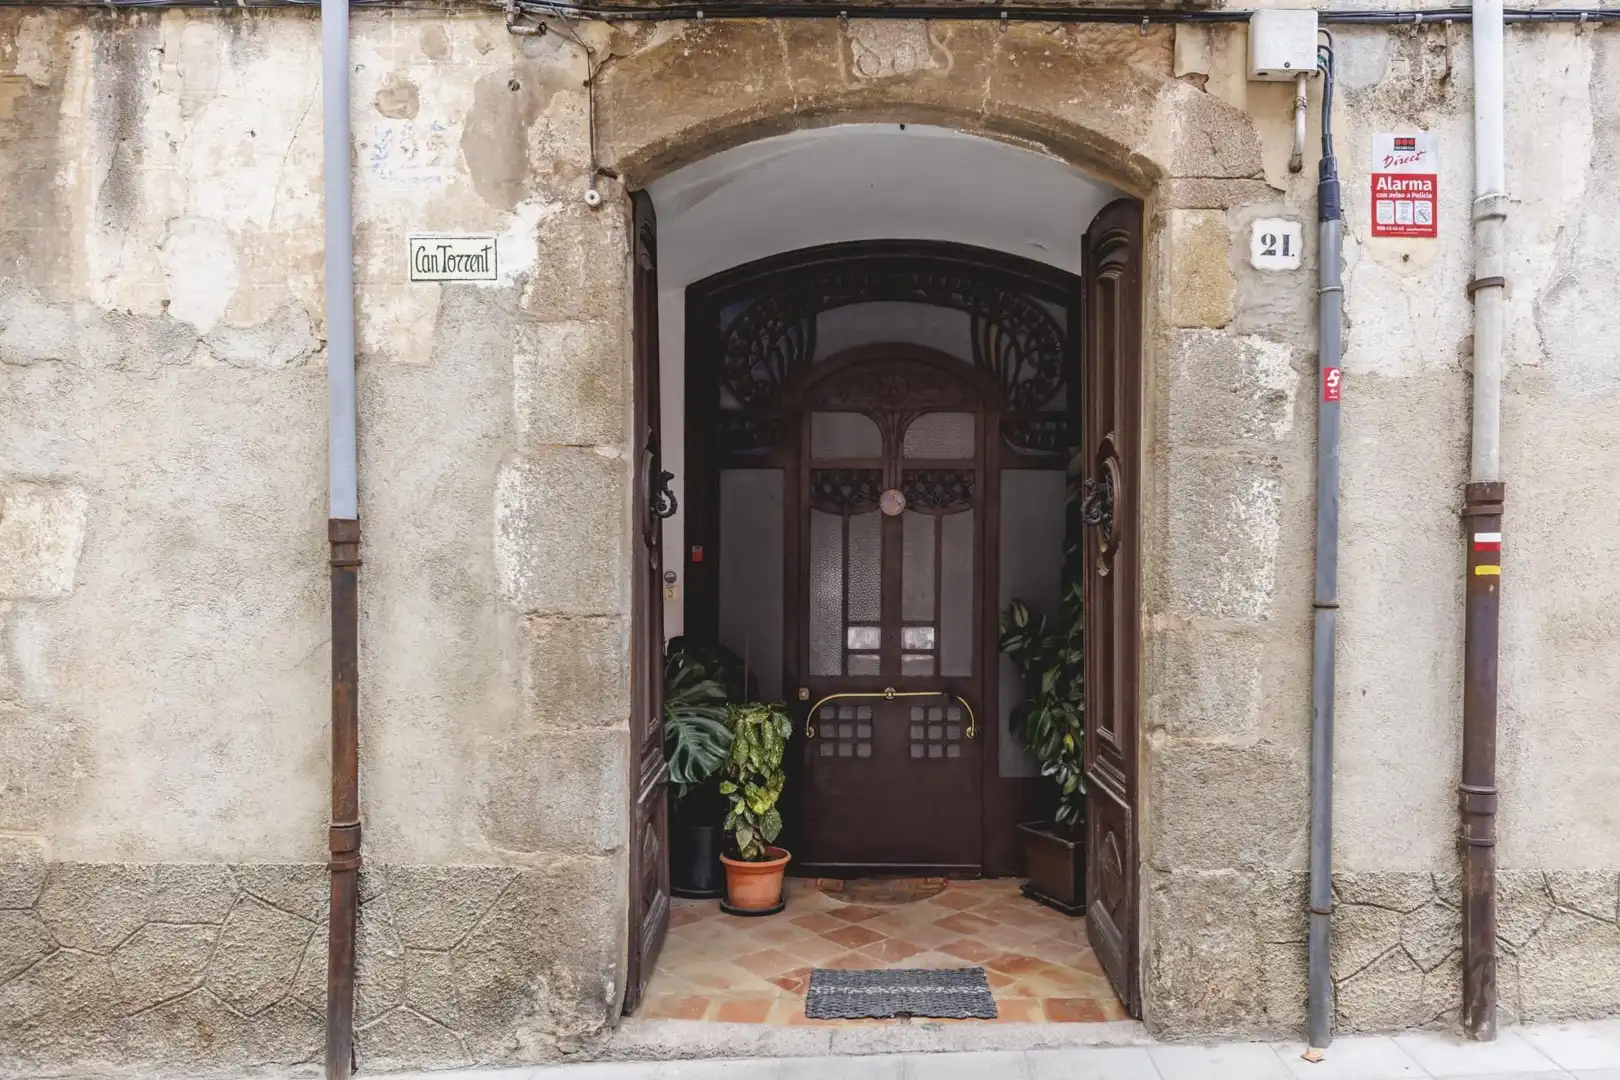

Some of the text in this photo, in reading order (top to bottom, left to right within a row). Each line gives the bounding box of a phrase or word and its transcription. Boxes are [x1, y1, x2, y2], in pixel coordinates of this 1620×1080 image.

[1383, 151, 1427, 169] Direct
[1376, 176, 1432, 190] Alarma
[415, 244, 493, 273] Can Torrent
